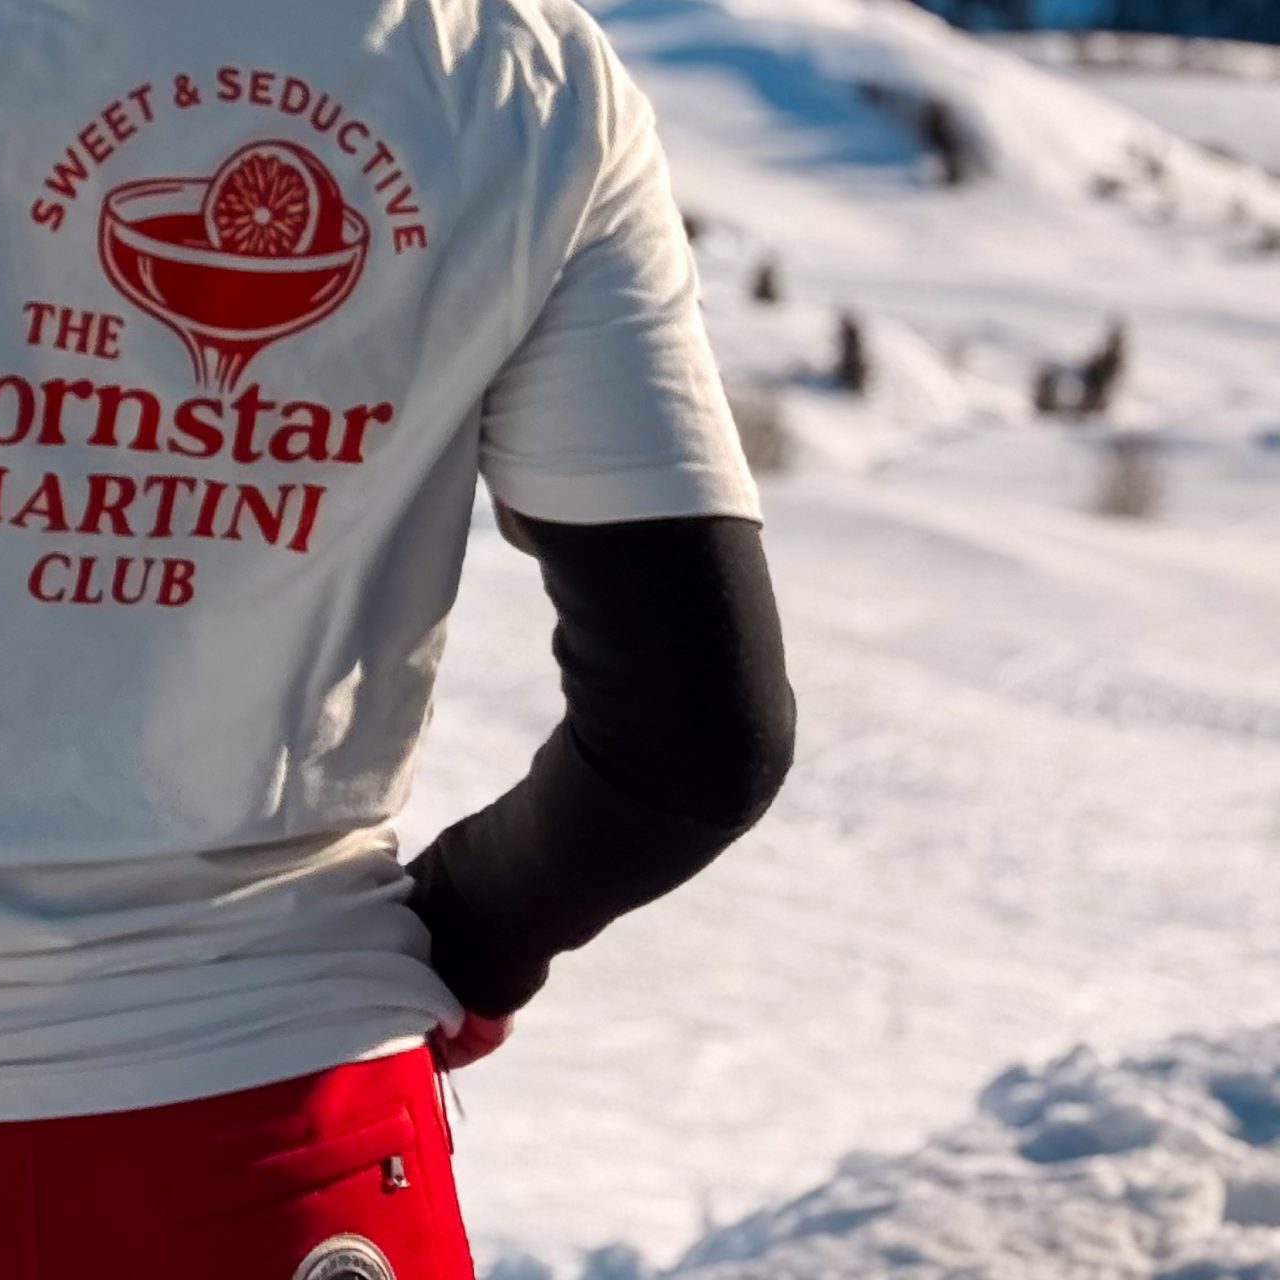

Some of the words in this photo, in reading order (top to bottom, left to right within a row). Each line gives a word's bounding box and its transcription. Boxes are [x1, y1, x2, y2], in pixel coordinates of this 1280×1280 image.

[31, 84, 153, 231] SWEET
[174, 74, 201, 108] &
[217, 66, 427, 253] SEDUCTIVE
[23, 300, 125, 359] THE
[28, 553, 196, 607] CLUB
